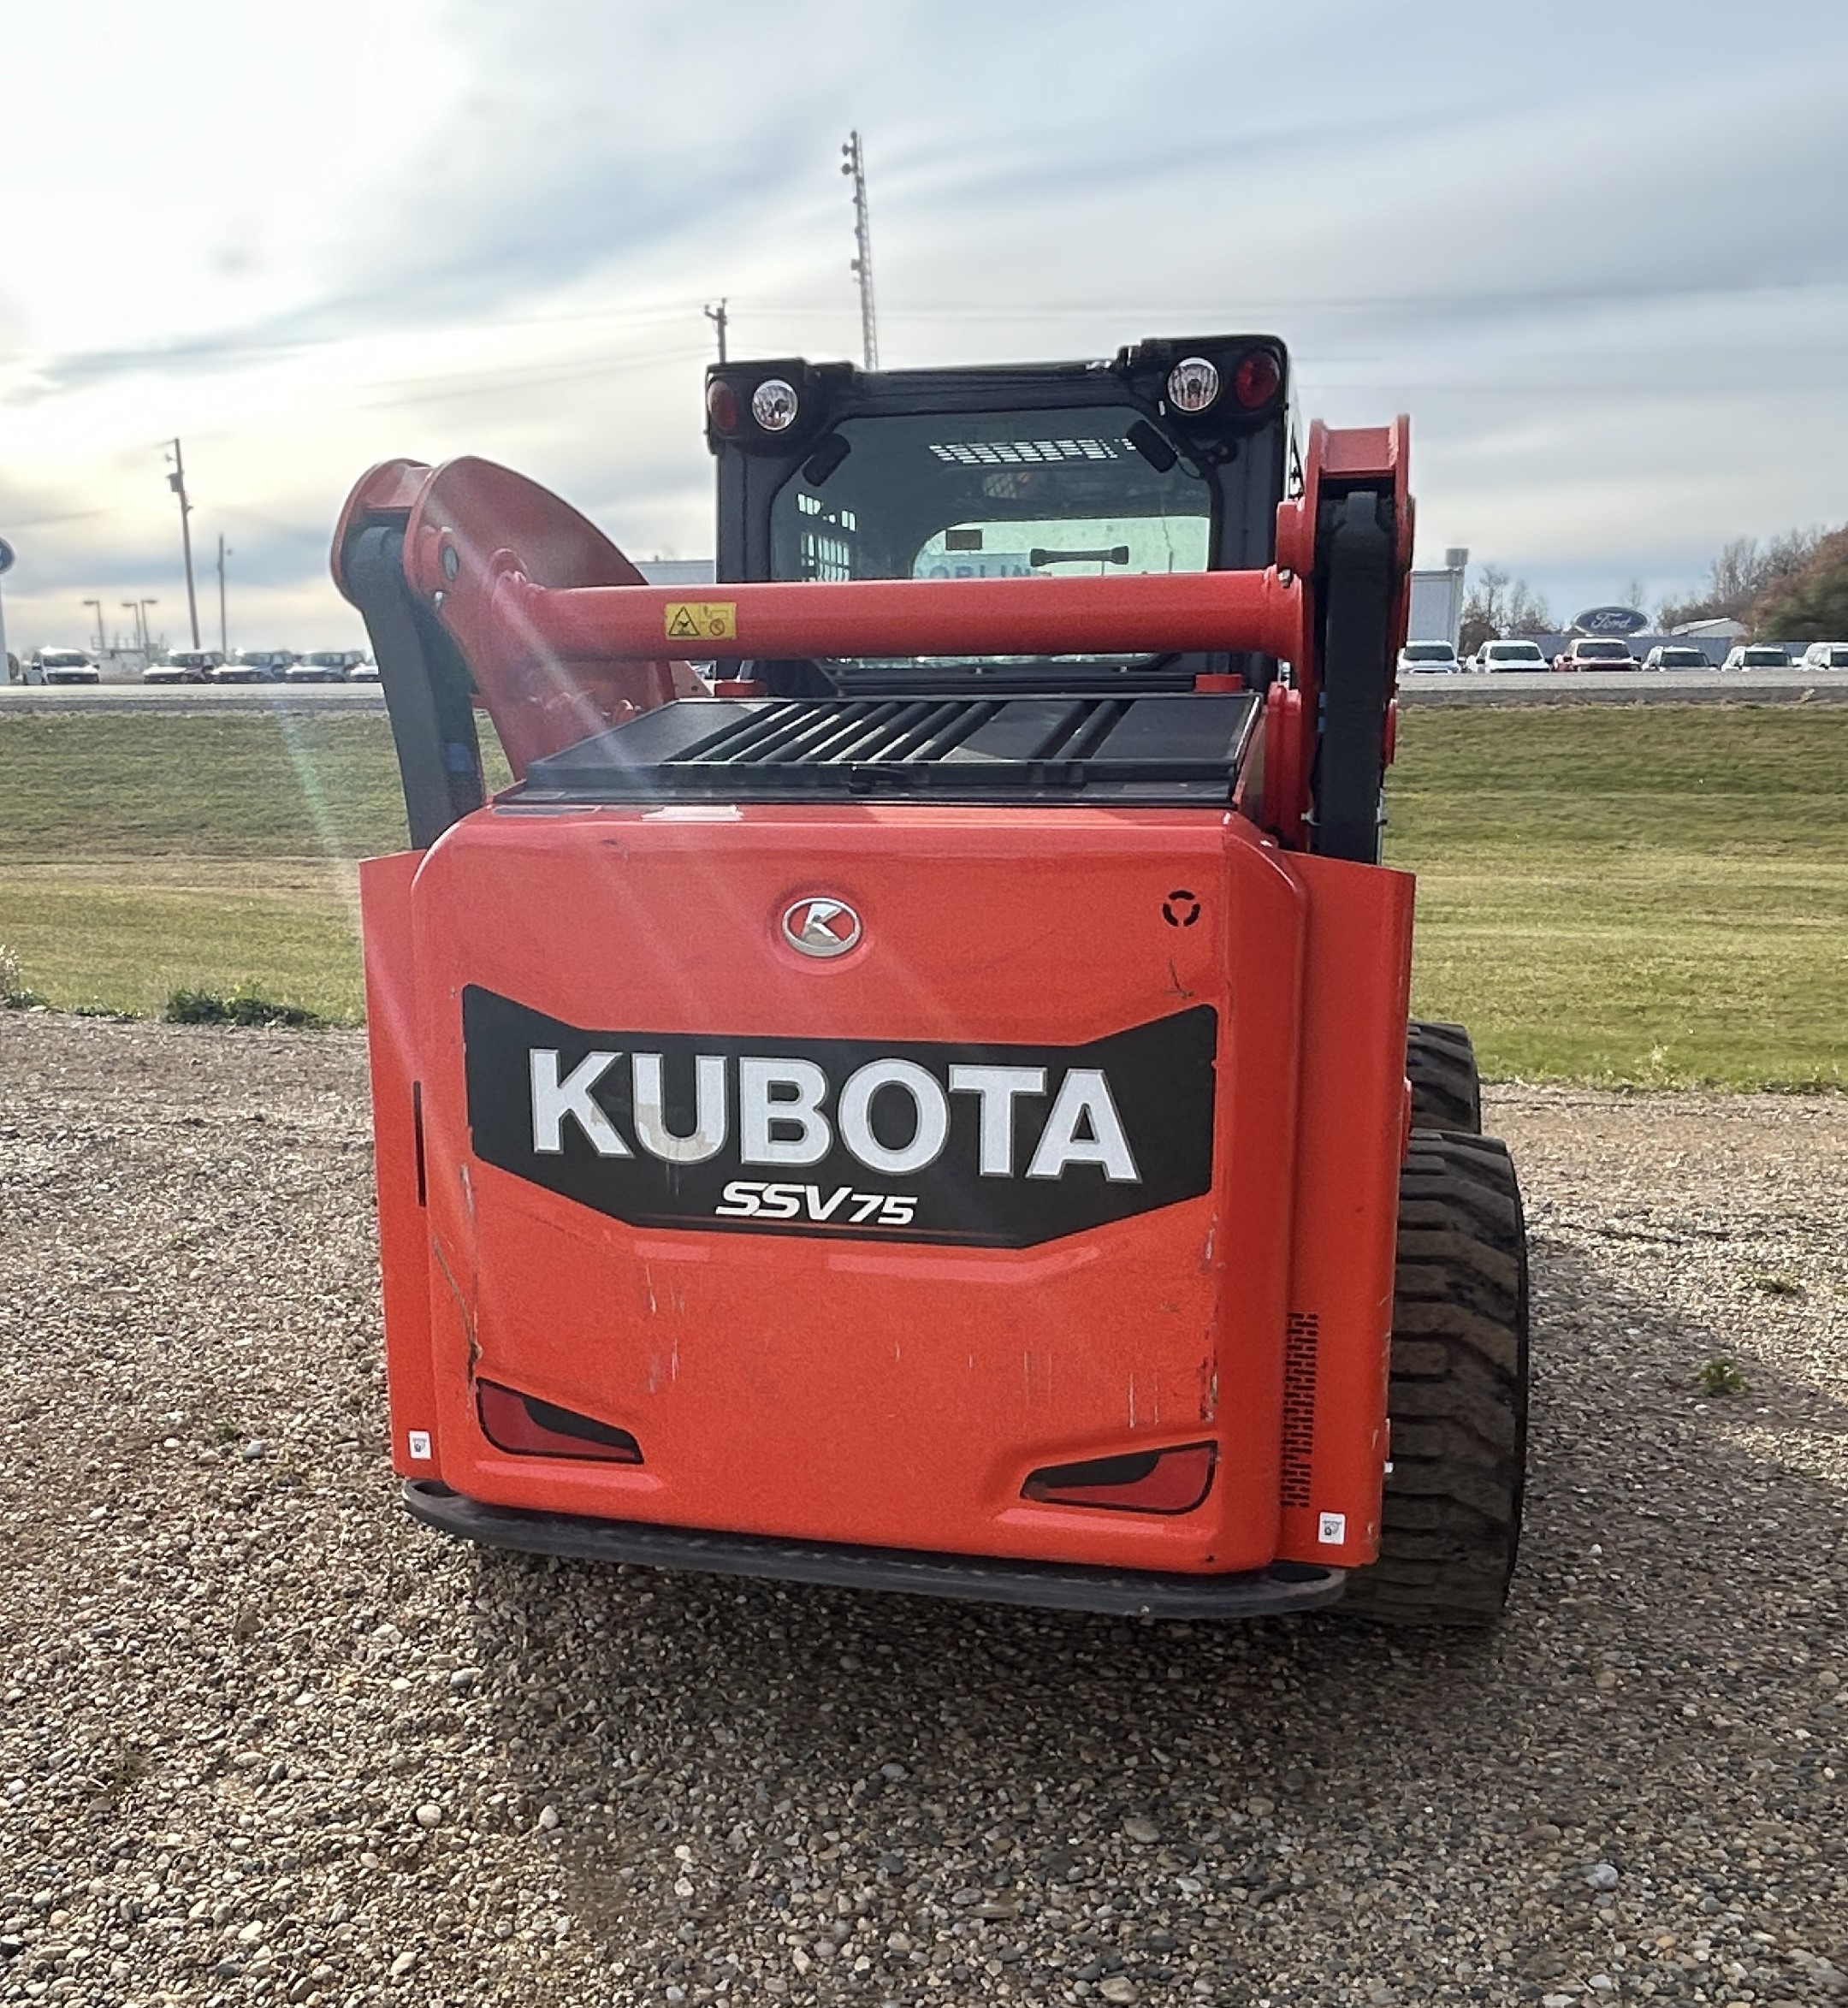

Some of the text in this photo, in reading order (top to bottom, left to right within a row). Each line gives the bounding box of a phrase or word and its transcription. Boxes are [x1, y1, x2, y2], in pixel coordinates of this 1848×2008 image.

[1590, 612, 1631, 630] Ford
[528, 1048, 1143, 1184] KUBOTA
[715, 1181, 918, 1226] SSV75
